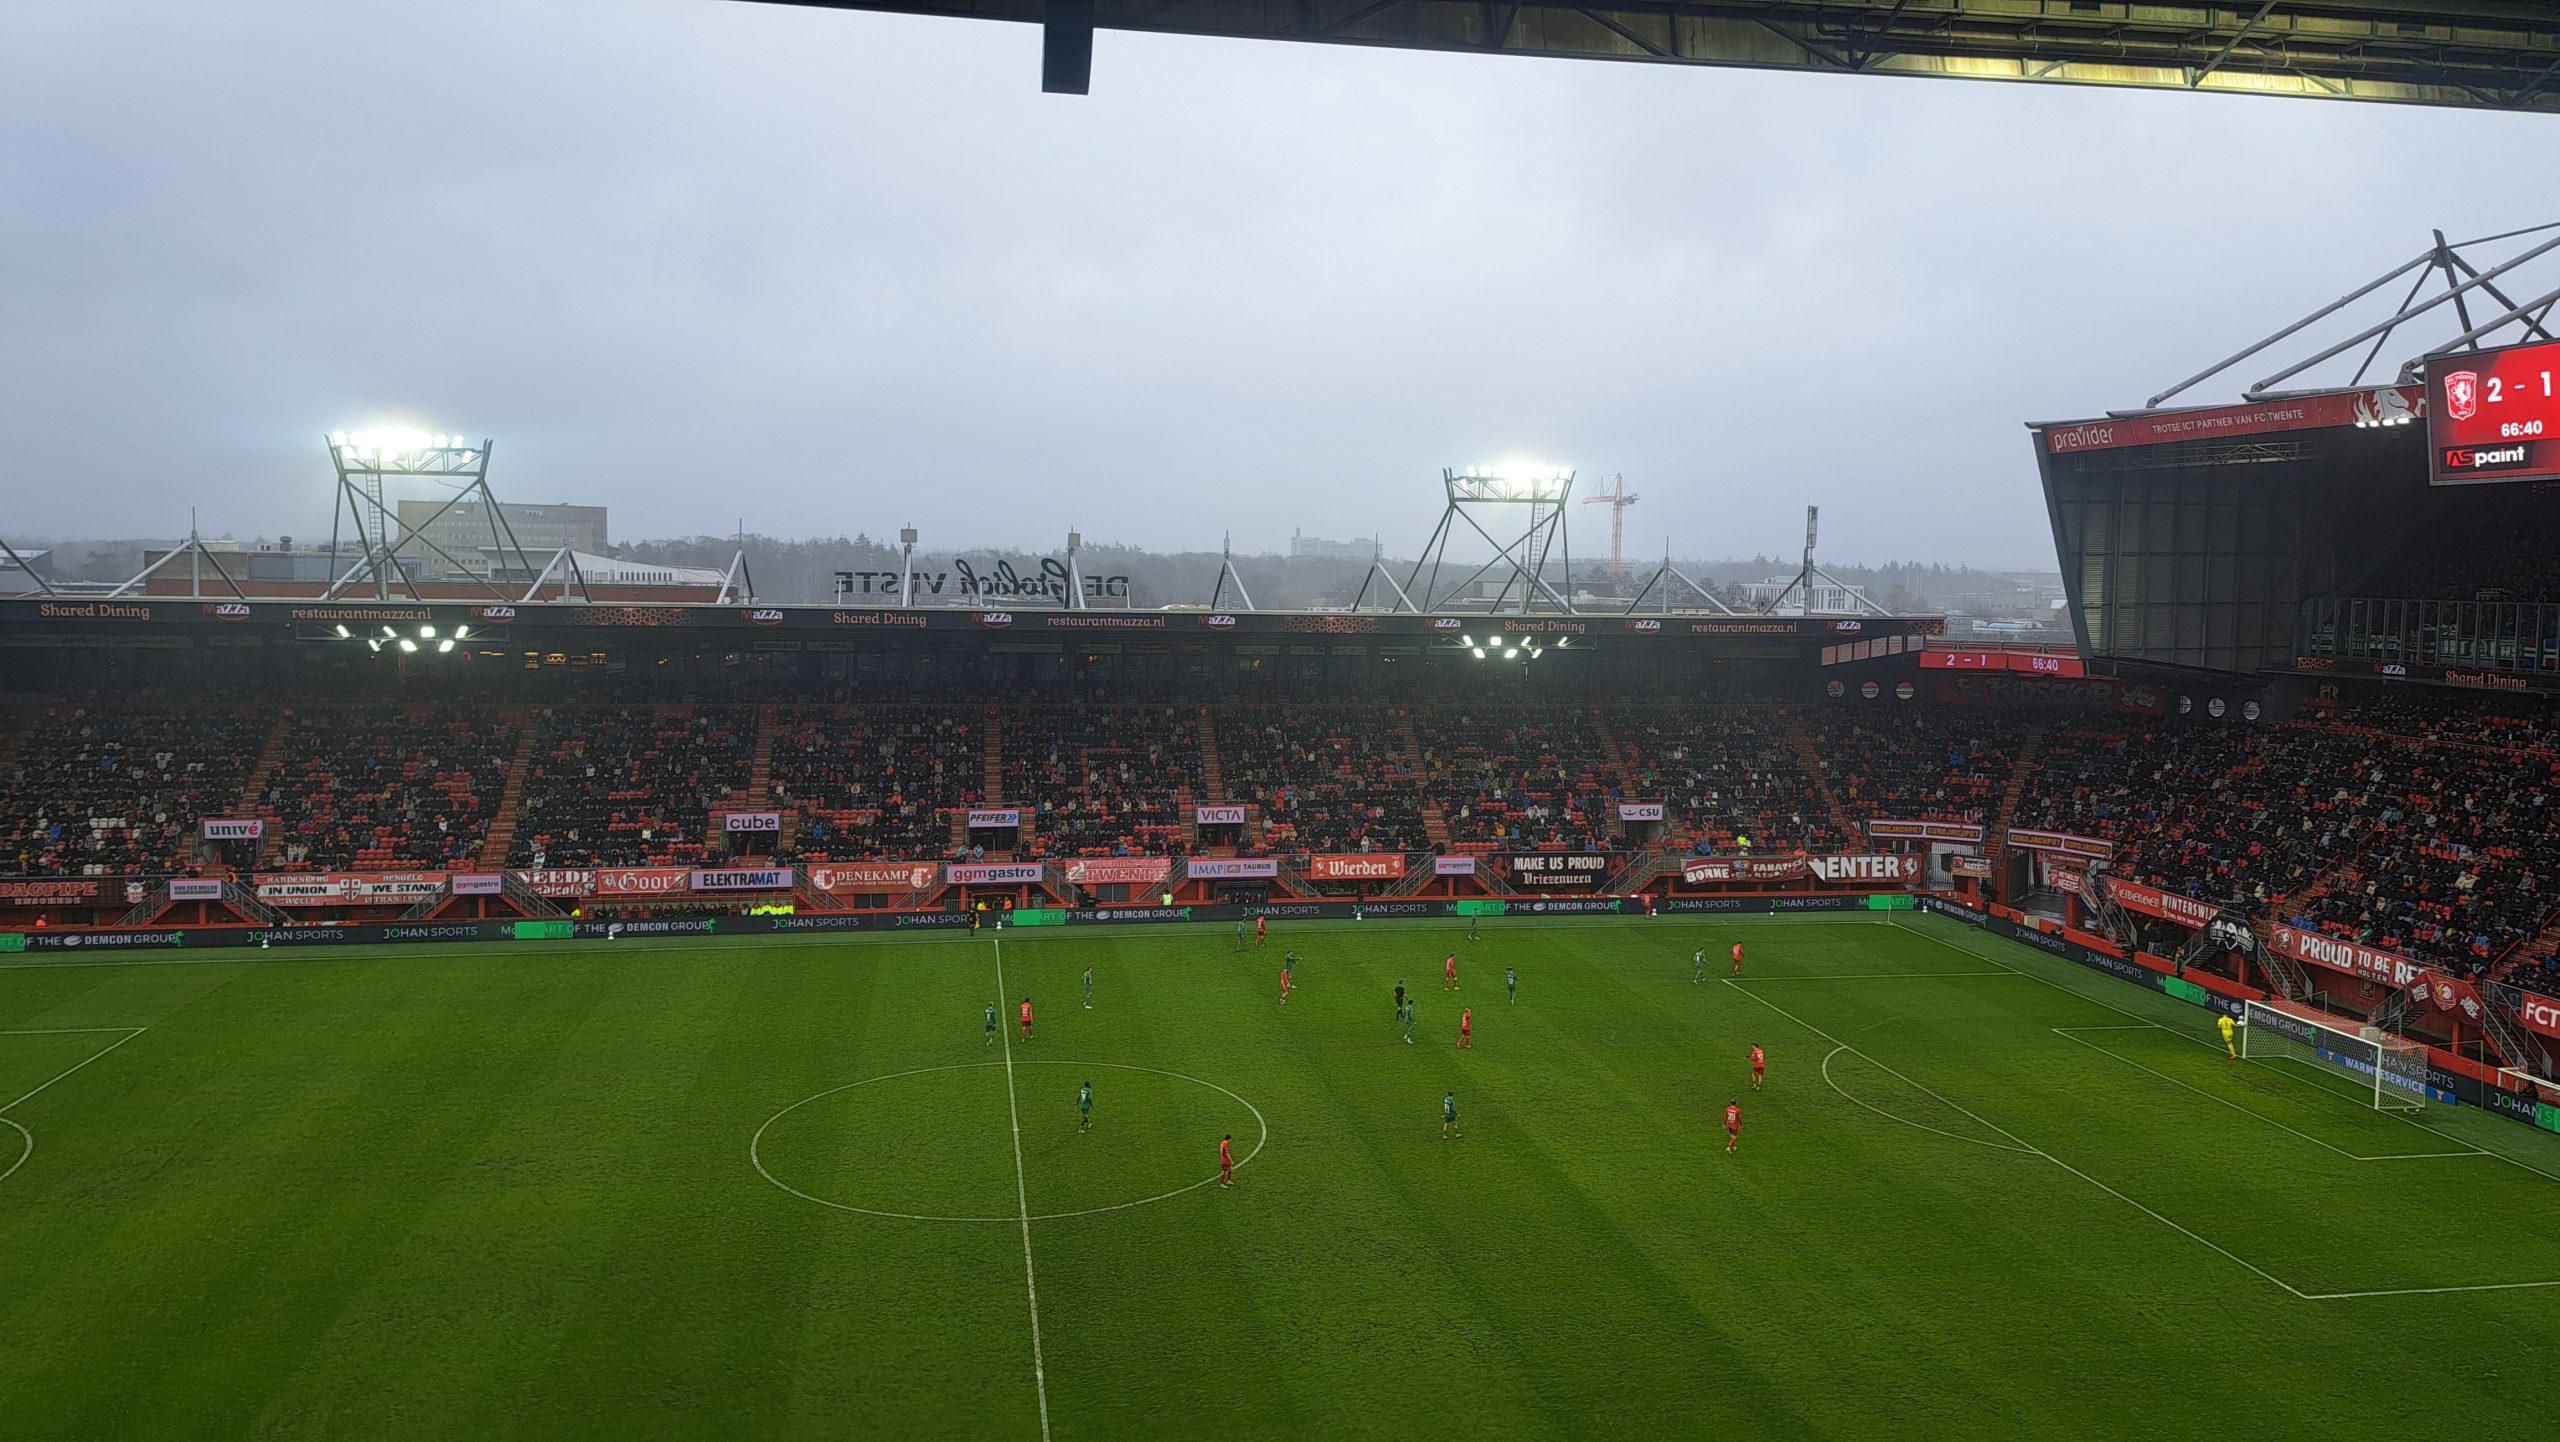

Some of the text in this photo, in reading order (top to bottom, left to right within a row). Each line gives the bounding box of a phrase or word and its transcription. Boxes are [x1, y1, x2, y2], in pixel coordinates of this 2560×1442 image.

[2486, 377, 2503, 403] 2
[2540, 370, 2552, 397] 1
[2152, 410, 2303, 435] TROTSE ICT PARTNER VAN FC TWENTE
[2500, 421, 2543, 437] 66:40
[2054, 426, 2113, 452] previder
[40, 604, 150, 621] Shared Dining
[292, 608, 432, 620] restaurantmazza.nl
[834, 612, 927, 628] Shared Dining
[1047, 615, 1165, 628] restaurantmazza.nl
[1504, 620, 1585, 634] Shared Dining
[1692, 621, 1798, 633] restaurantmazza.nl
[1946, 654, 1955, 666] 2
[1980, 654, 1987, 666] 1
[2032, 657, 2059, 672] 66:40
[2446, 670, 2527, 689] Shared Dining
[970, 813, 1007, 822] PFEIFER
[1201, 809, 1241, 821] VICTA
[1638, 808, 1660, 820] CSU
[209, 821, 259, 836] univé
[1194, 864, 1224, 875] IMAP
[1328, 860, 1388, 876] Wierden
[1513, 856, 1605, 871] MAKE US PROUD
[1826, 856, 1900, 879] ENTER
[703, 872, 781, 887] ELEKTRAMAT
[836, 871, 909, 882] DENEKAMP
[953, 865, 1037, 882] ggmgastro
[1086, 867, 1167, 882] TWENTE
[372, 883, 436, 893] WE STAND
[455, 880, 499, 890] ggmgastro
[618, 872, 673, 891] Goor
[268, 885, 328, 896] IN UNION
[1242, 904, 1320, 916] JOHAN SPORTS
[1352, 902, 1428, 915] JOHAN SPORTS
[1513, 901, 1532, 911] THE
[1548, 900, 1583, 911] DEMCON
[1584, 899, 1617, 910] GROUP
[1667, 898, 1741, 910] JOHAN SPORTS
[1769, 897, 1842, 909] JOHAN SPORTS
[1920, 896, 1936, 906] THE
[1943, 901, 1964, 917] DEMCON
[1964, 908, 1985, 923] GROUP
[895, 915, 968, 927] JOHAN SPOR
[1073, 911, 1095, 921] THE
[1112, 909, 1155, 919] DEMCON
[1156, 908, 1187, 918] GROUP
[585, 923, 606, 933] THE
[626, 921, 669, 932] DEMCON
[670, 920, 710, 931] GROUP
[771, 917, 859, 929] JOHAN SPORTS
[36, 935, 63, 946] THE
[84, 934, 131, 945] DEMCON
[134, 932, 176, 944] GROUP
[246, 929, 345, 943] JOHAN SPORTS
[382, 925, 478, 940] JOHAN SPORTS
[2015, 926, 2066, 952] JOHAN SPORTS
[2085, 950, 2144, 979] JOHAN SPORTS
[2299, 934, 2427, 986] PROUD TO BE RE
[2357, 968, 2388, 983] HOLTEN
[2212, 996, 2231, 1010] THE
[2248, 1007, 2277, 1028] EMCON
[2278, 1015, 2310, 1039] GROUP
[2492, 1091, 2542, 1119] JOHAN
